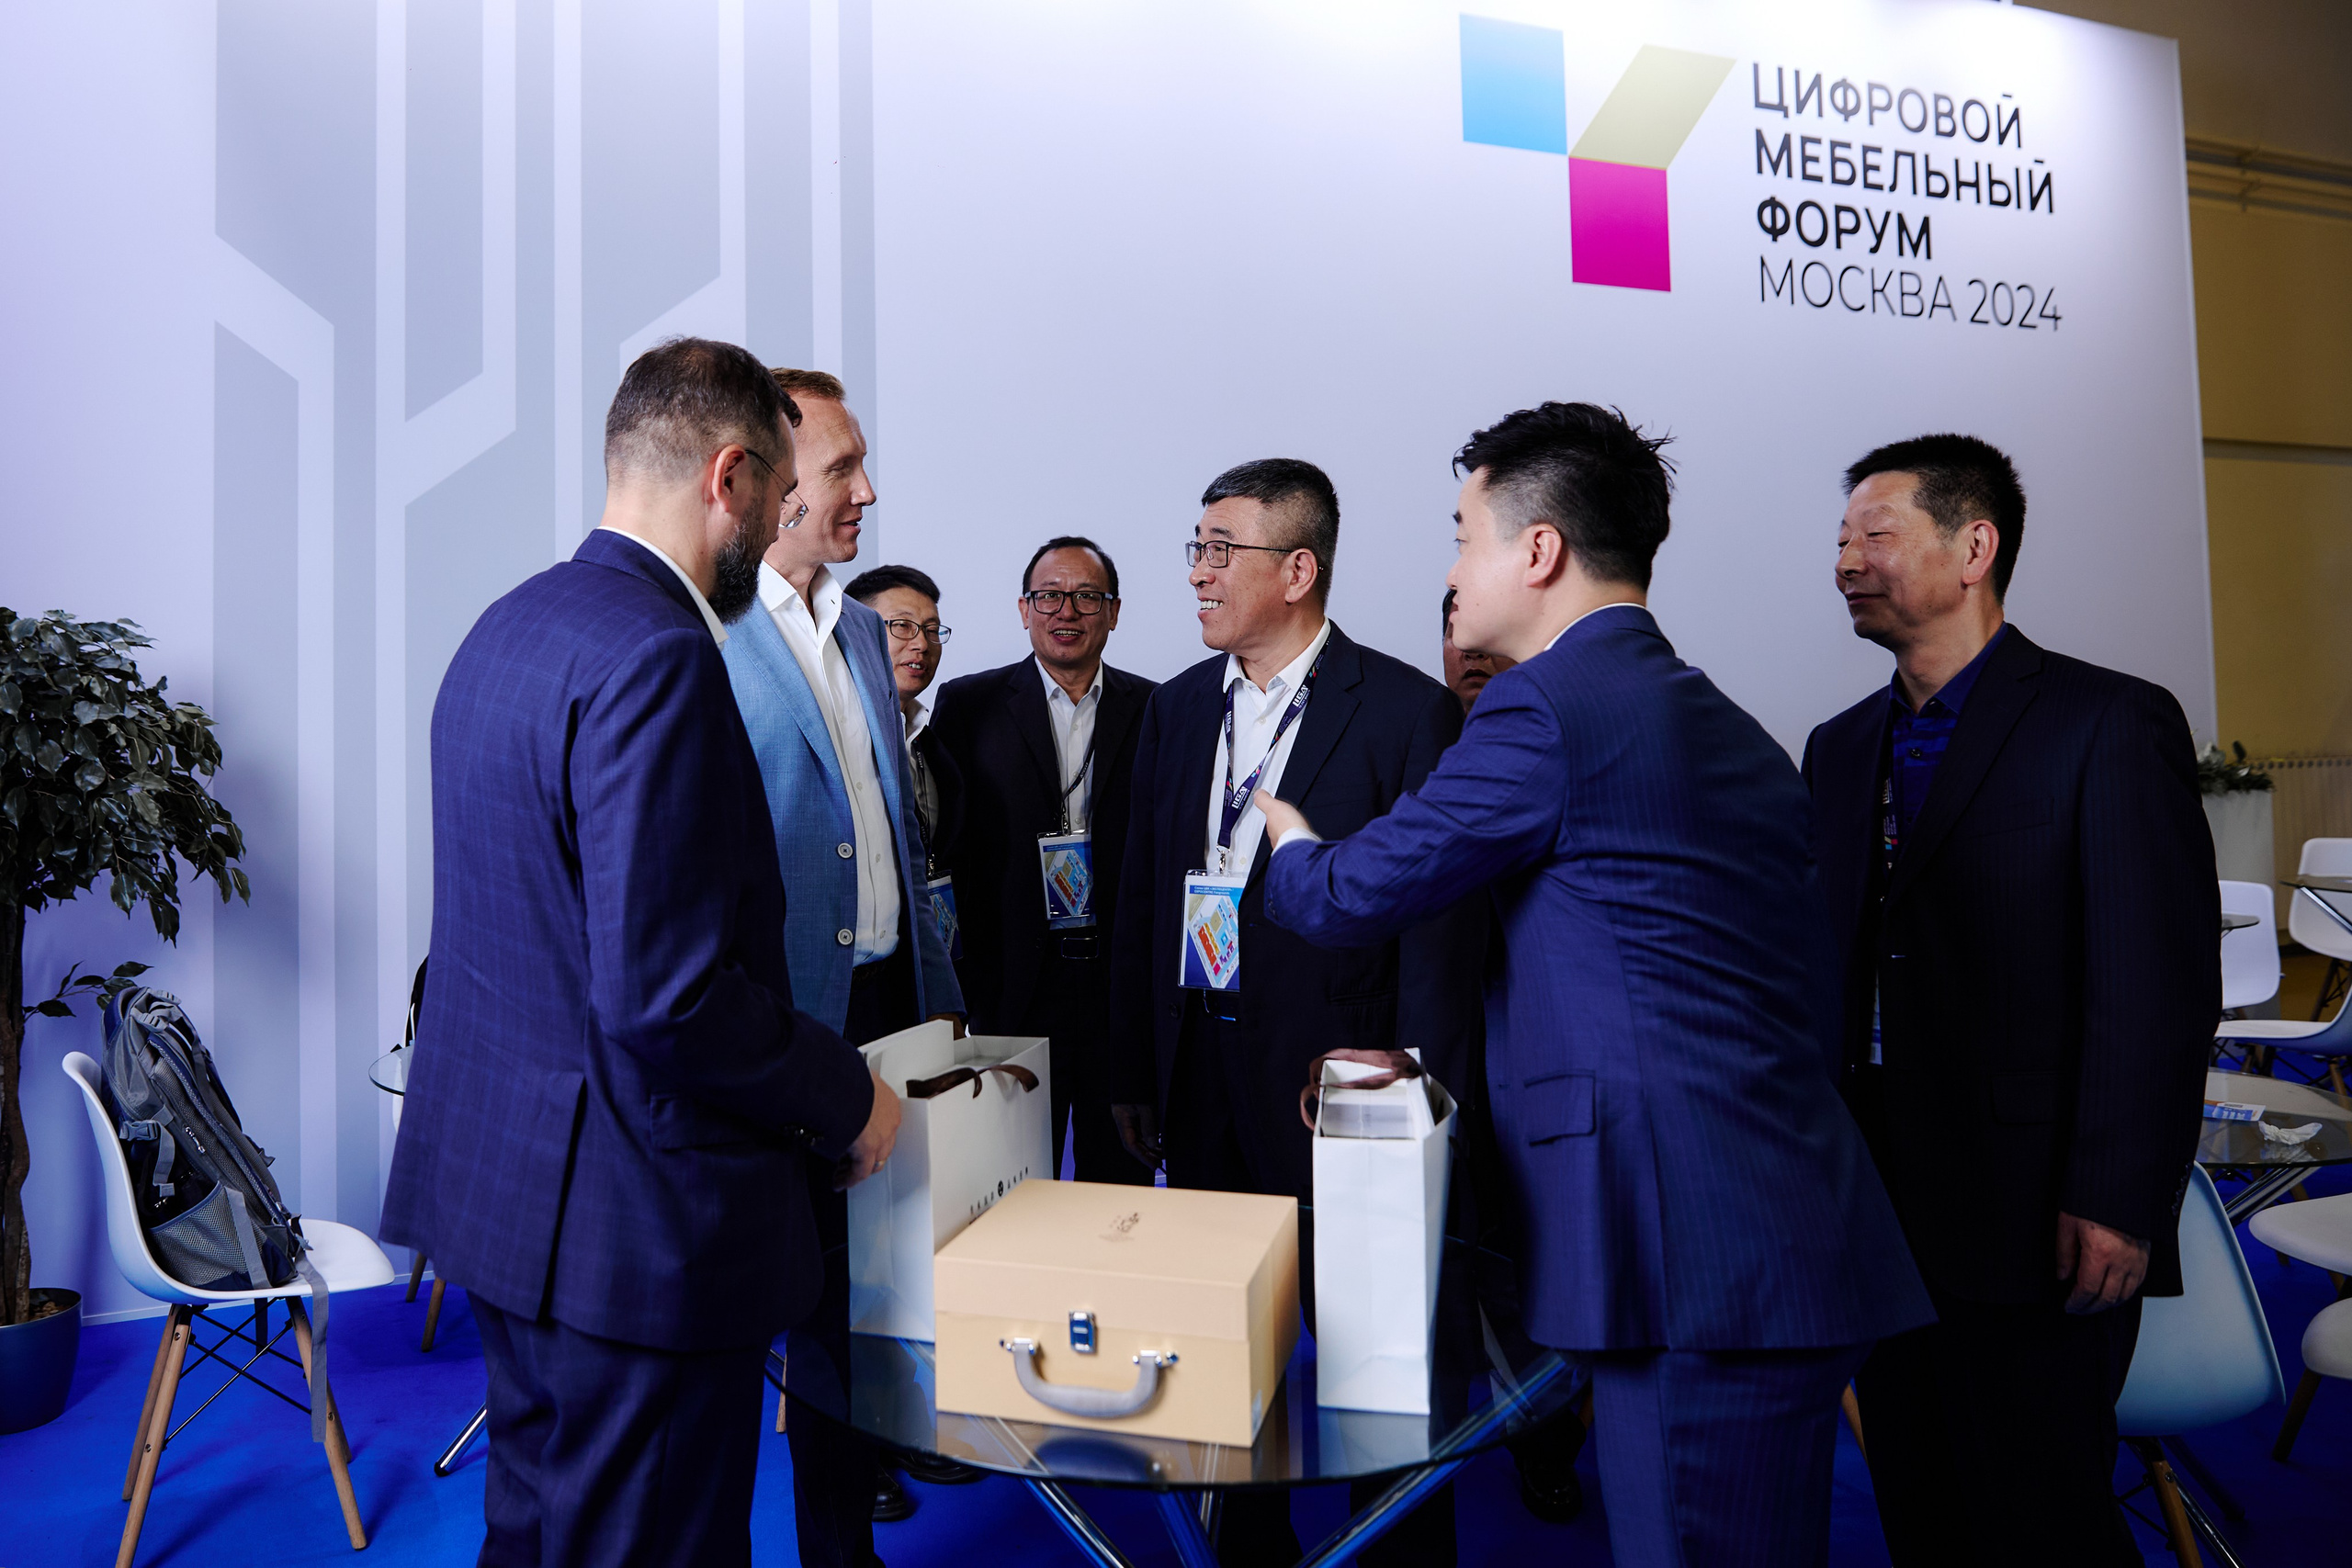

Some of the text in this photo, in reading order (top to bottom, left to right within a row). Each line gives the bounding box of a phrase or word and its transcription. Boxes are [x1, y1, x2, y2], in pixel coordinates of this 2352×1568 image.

[1752, 62, 2022, 149] ЦИФРОВОЙ
[1755, 128, 2055, 215] МЕБЕЛЬНЫЙ
[1757, 196, 1933, 260] ФОРУМ
[1759, 254, 2064, 332] МОСКВА 2024
